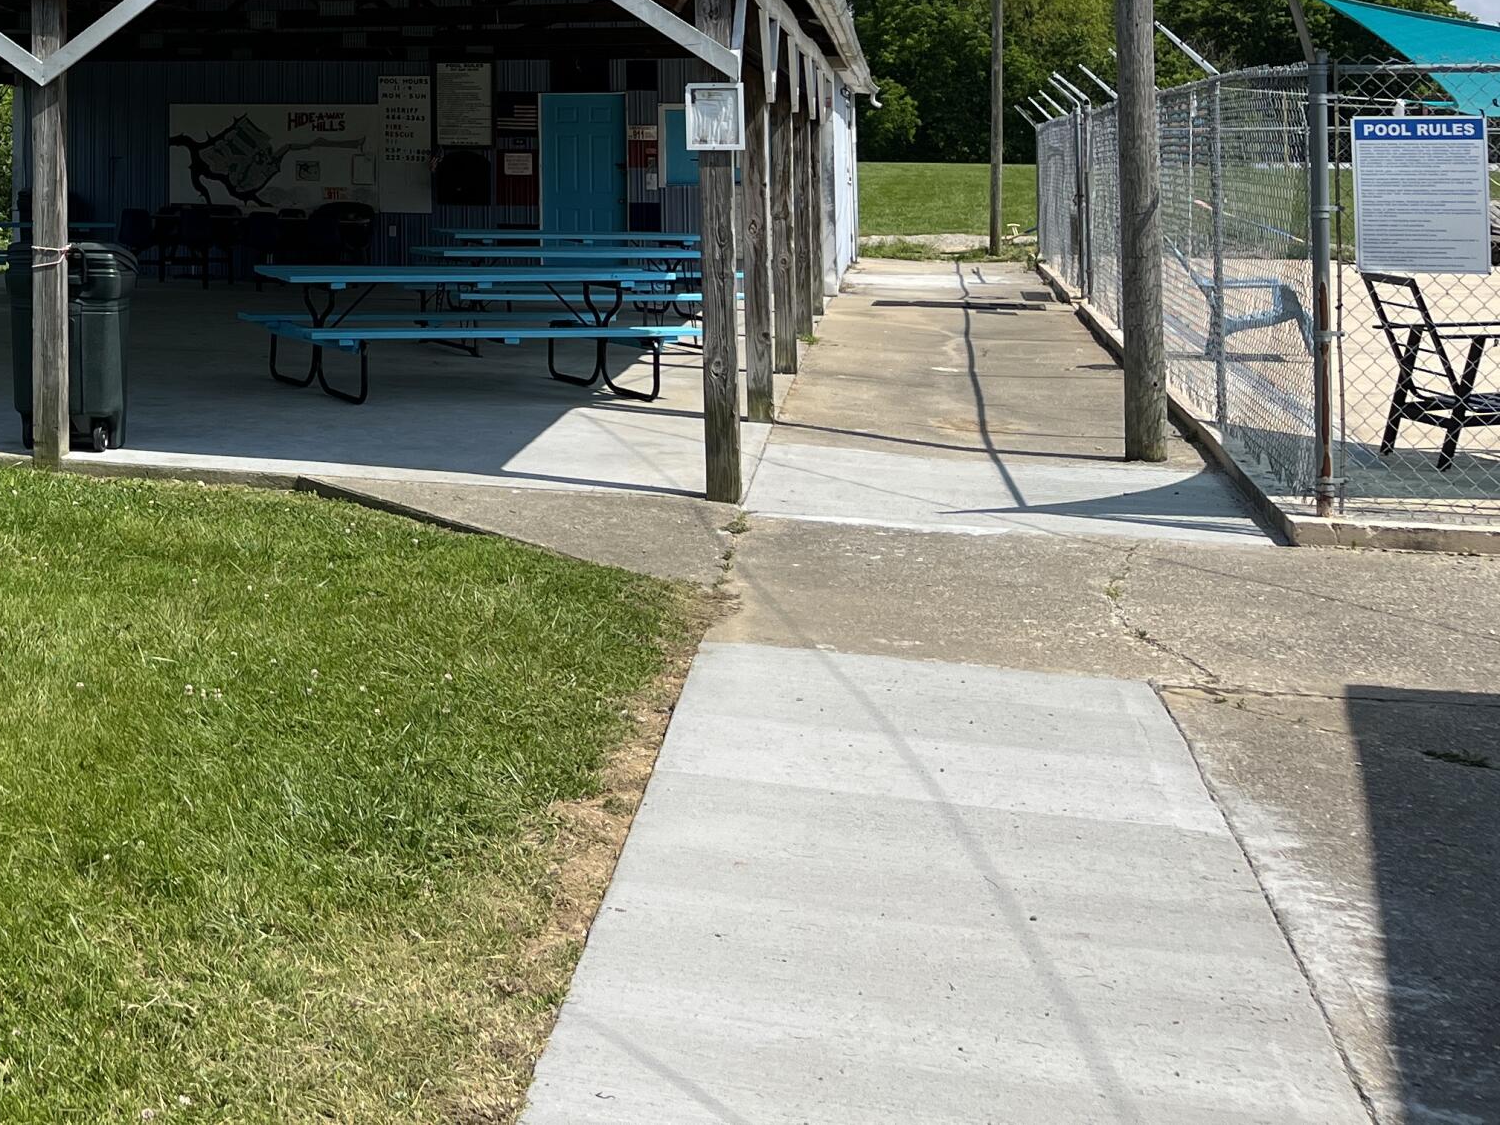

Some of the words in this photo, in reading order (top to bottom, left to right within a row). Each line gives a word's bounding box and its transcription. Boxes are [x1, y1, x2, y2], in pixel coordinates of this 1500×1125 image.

[311, 120, 345, 132] HILLS
[1363, 123, 1412, 136] POOL
[1416, 122, 1476, 136] RULES
[327, 190, 340, 200] 911
